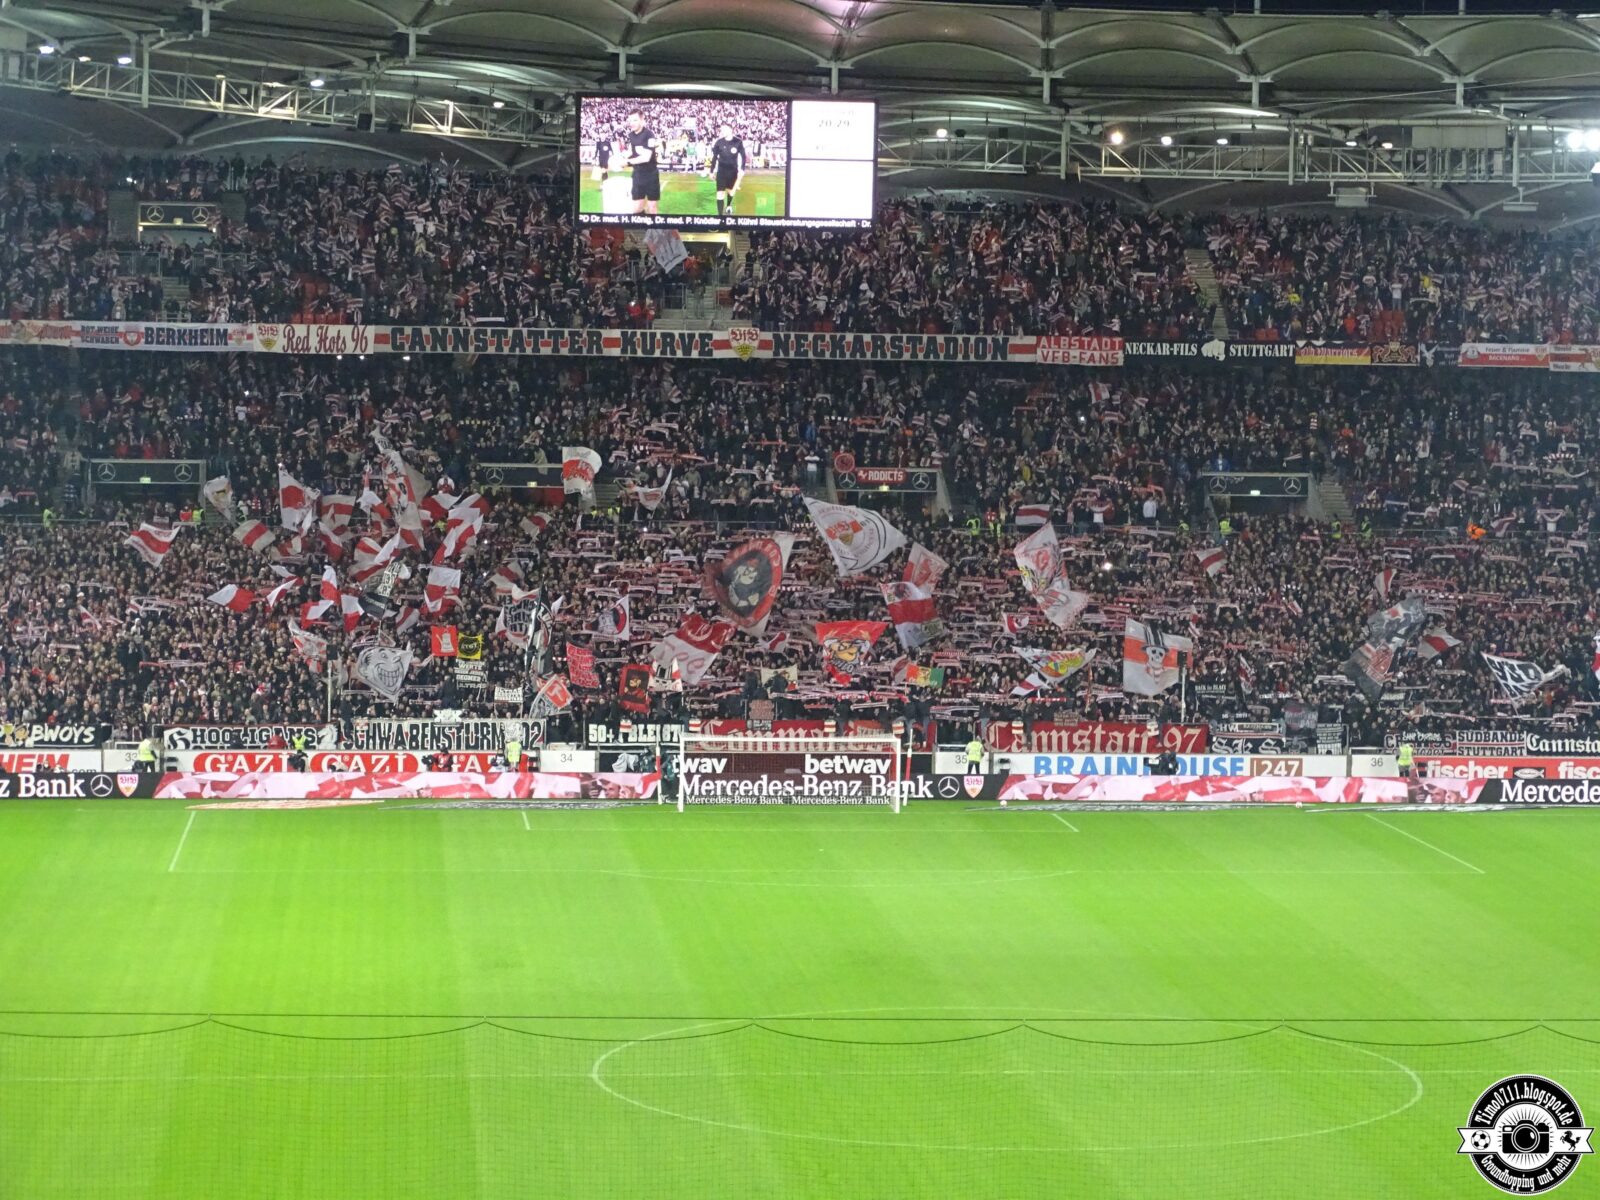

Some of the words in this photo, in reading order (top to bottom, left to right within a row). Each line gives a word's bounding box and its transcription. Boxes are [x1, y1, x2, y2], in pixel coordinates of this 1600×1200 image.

[590, 214, 601, 223] Dr.
[602, 215, 619, 223] med.
[621, 215, 630, 223] H.
[655, 215, 666, 224] Dr.
[667, 216, 684, 225] med.
[686, 216, 693, 225] P.
[726, 217, 737, 226] Dr.
[861, 219, 872, 228] Dr.
[144, 326, 229, 347] BERKHEIM
[282, 324, 311, 353] Red
[315, 324, 347, 353] Hots
[351, 324, 369, 353] 96
[390, 327, 603, 353] CANNSTATTER
[620, 331, 714, 357] KURVE
[772, 332, 1011, 360] NECKARSTADION
[1037, 336, 1124, 350] ALBSTADT
[1041, 350, 1120, 365] VFB-FANS
[1125, 341, 1198, 356] NECKAR-FILS
[1229, 343, 1296, 358] STUTTGART
[31, 724, 96, 744] BWOYS
[1162, 726, 1202, 753] 97
[560, 753, 573, 763] 34
[955, 754, 968, 764] 35
[1458, 746, 1525, 757] STUTTGART
[804, 754, 892, 774] betway
[1034, 755, 1245, 775] BRAINOUSE
[1260, 760, 1300, 775] 247
[1371, 757, 1384, 767] 36
[1427, 760, 1508, 779] fischer
[17, 773, 86, 798] Bank
[677, 774, 863, 797] Mercedes-Benz
[869, 774, 935, 799] Bank
[686, 795, 758, 805] Mercedes-Benz
[760, 796, 785, 805] Bank
[791, 796, 862, 806] Mercedes-Benz
[865, 797, 890, 806] Bank
